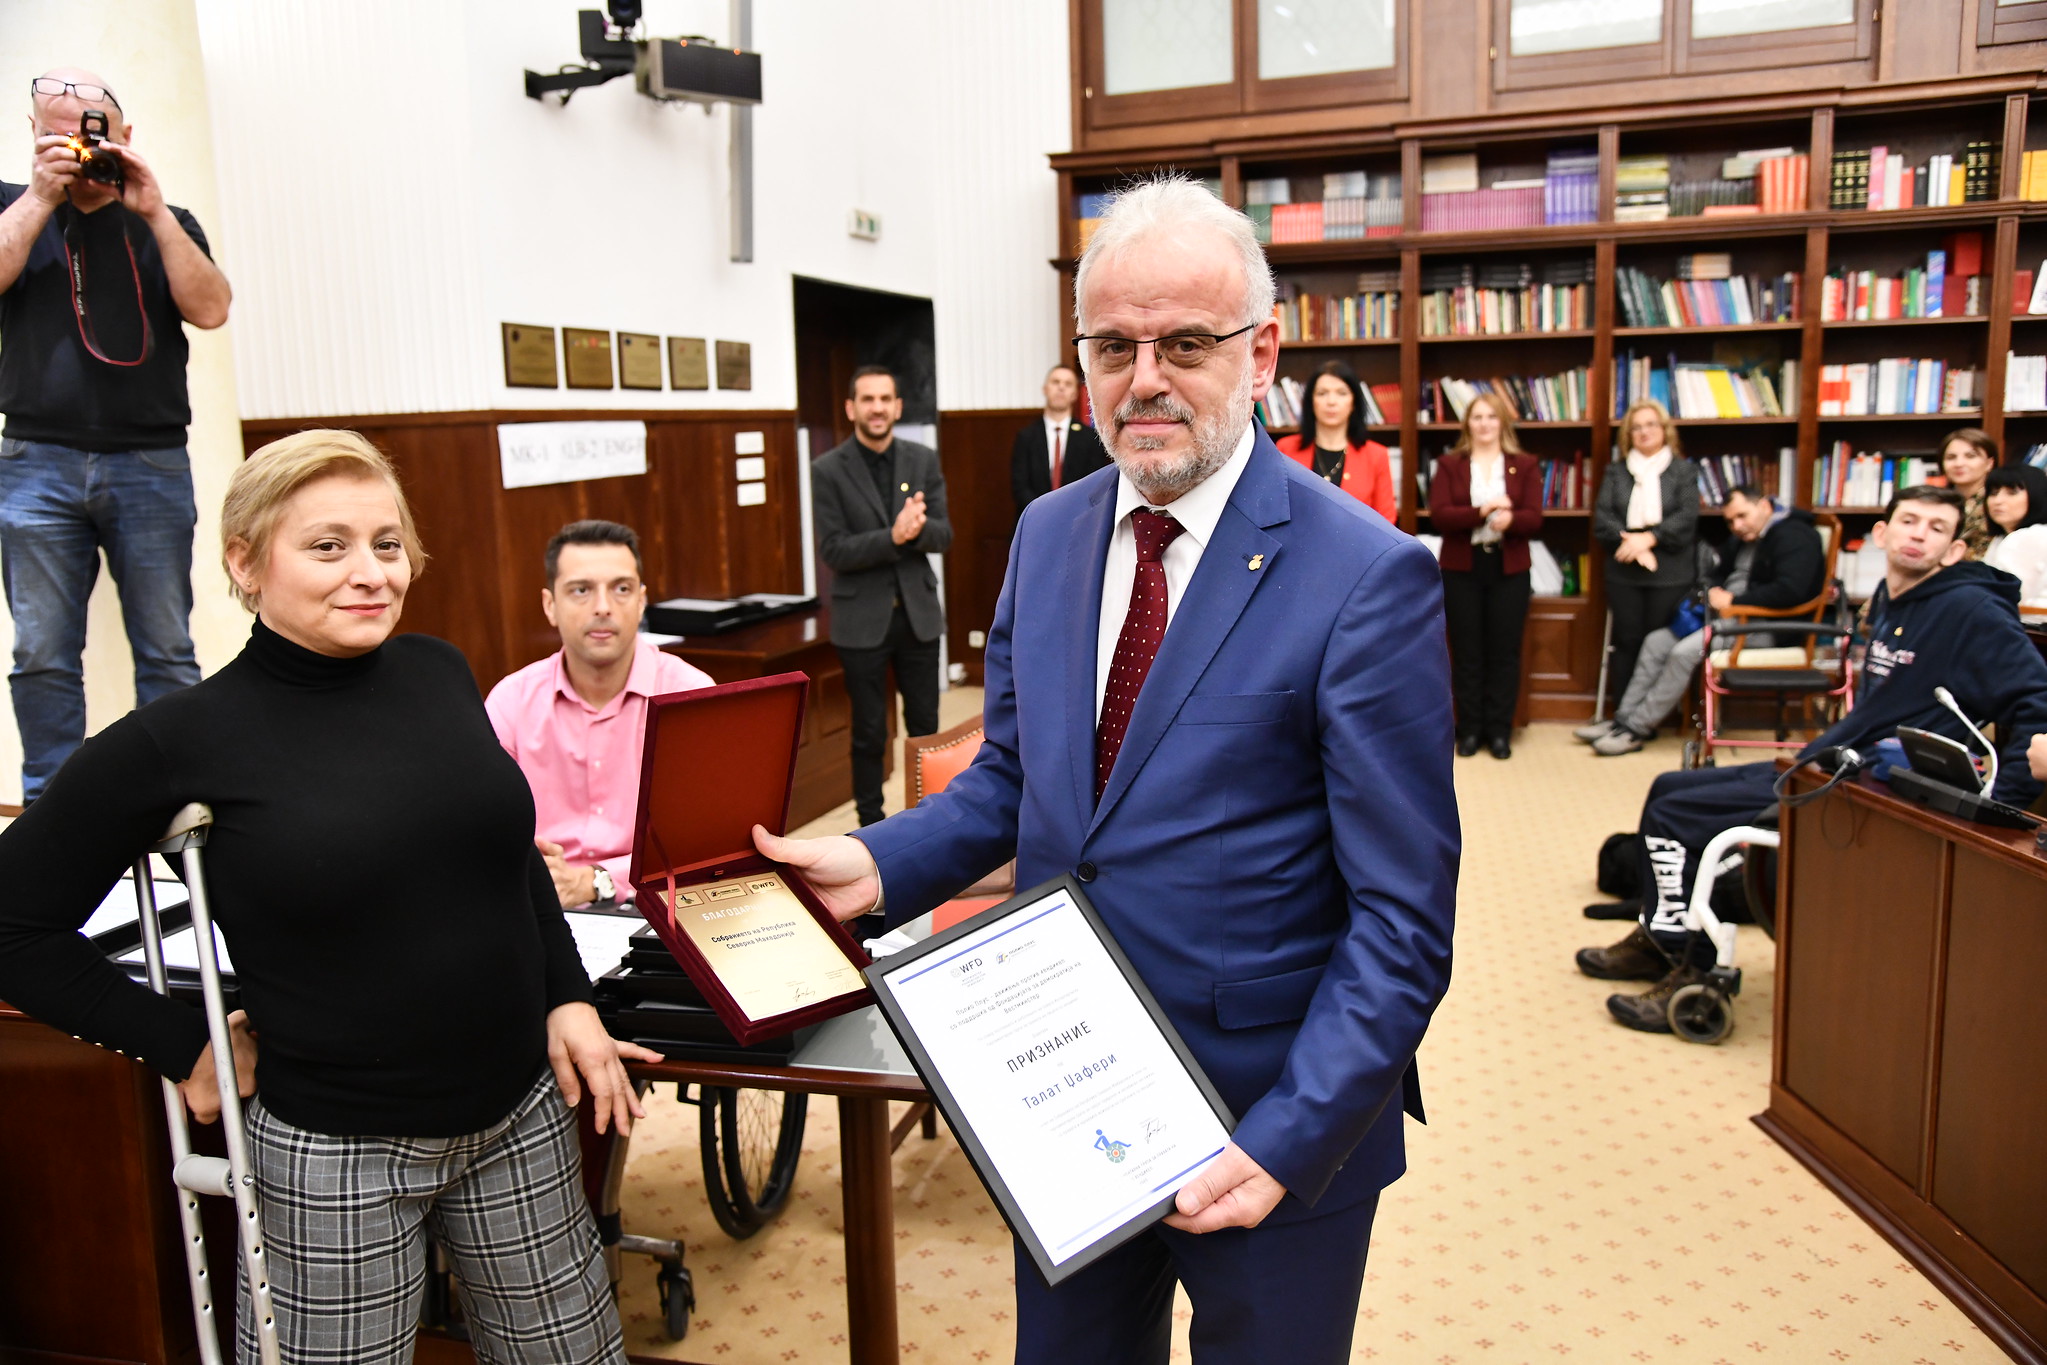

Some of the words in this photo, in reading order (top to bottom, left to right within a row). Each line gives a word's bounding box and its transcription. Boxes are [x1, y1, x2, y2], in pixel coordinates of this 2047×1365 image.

[759, 881, 775, 889] WFD
[711, 929, 752, 943] Собранието
[761, 920, 797, 934] Република
[726, 939, 756, 950] Северна
[756, 930, 795, 945] Македонија
[959, 957, 983, 974] WFD
[1006, 1020, 1092, 1073] ПРИЗНАНИЕ
[1021, 1080, 1063, 1110] Талат
[1063, 1051, 1119, 1089] Џафери
